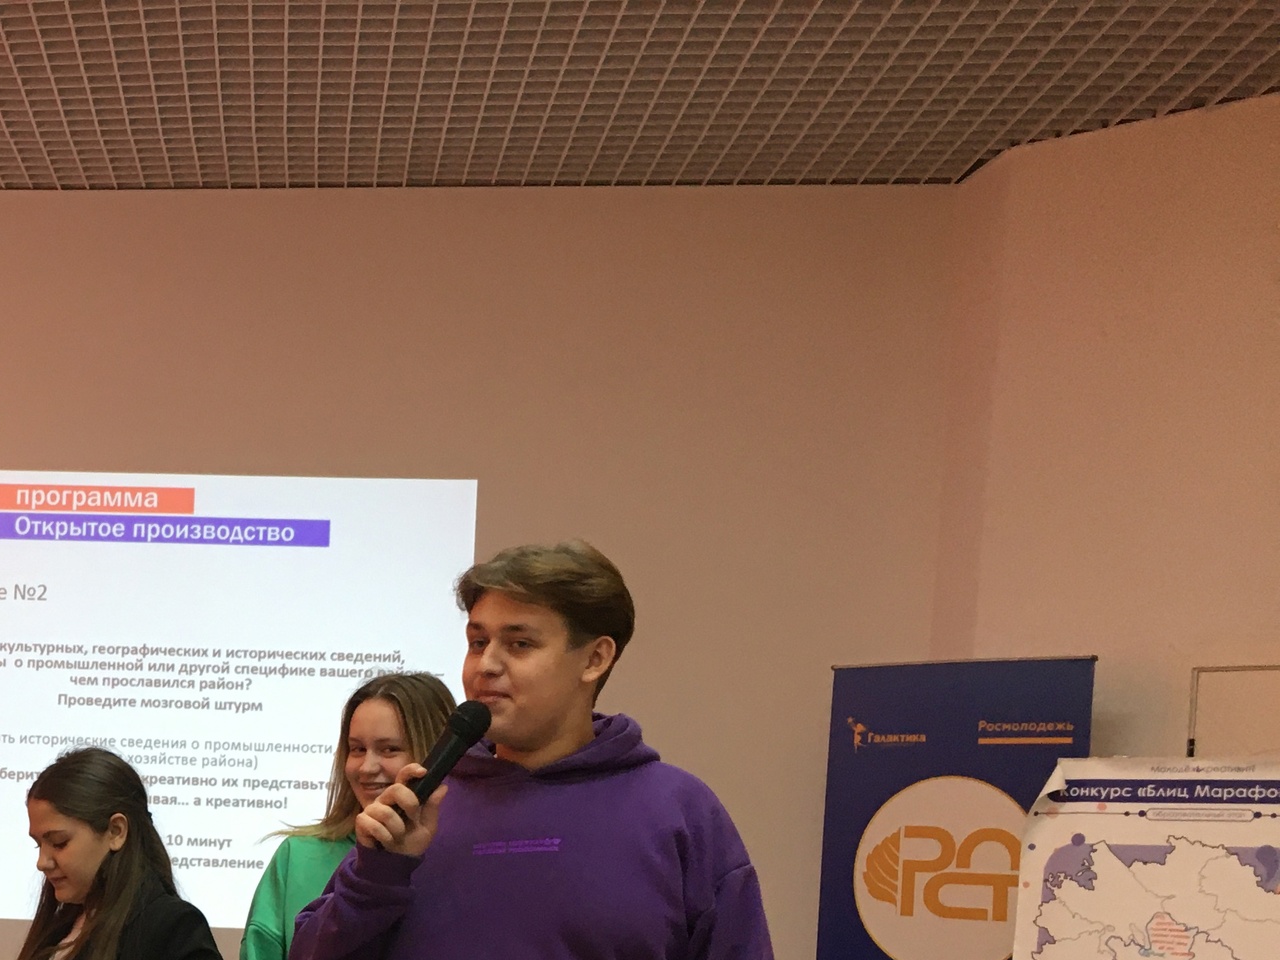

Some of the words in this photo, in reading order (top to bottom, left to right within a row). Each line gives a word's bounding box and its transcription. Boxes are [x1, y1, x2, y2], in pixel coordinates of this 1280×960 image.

[16, 489, 159, 510] программа
[14, 516, 125, 540] Открытое
[133, 522, 295, 543] производство
[13, 584, 48, 601] №2
[0, 641, 88, 656] культурных,
[92, 643, 209, 659] географических
[212, 648, 221, 658] и
[225, 648, 326, 662] исторических
[330, 650, 406, 665] сведений,
[14, 658, 23, 668] о
[27, 657, 144, 673] промышленной
[148, 661, 175, 673] или
[178, 660, 231, 676] другой
[234, 664, 316, 678] специфике
[319, 667, 374, 679] вашего
[69, 675, 99, 687] чем
[102, 677, 195, 690] прославился
[199, 677, 253, 692] район?
[57, 693, 137, 709] Проведите
[140, 695, 210, 710] мозговой
[214, 700, 263, 714] штурм
[978, 720, 1074, 732] Росмолодежь
[19, 733, 117, 748] исторические
[120, 737, 187, 751] сведения
[191, 741, 200, 750] о
[867, 732, 927, 743] Галактика
[127, 751, 198, 766] хозяйстве
[201, 755, 258, 770] района)
[140, 774, 217, 787] креативно
[221, 777, 239, 788] их
[1060, 784, 1133, 800] Конкурс
[1137, 785, 1190, 799] «Блиц
[1194, 785, 1280, 801] Марафо
[193, 797, 202, 806] а
[205, 796, 288, 810] креативно!
[166, 833, 184, 847] 10
[186, 837, 233, 850] минут
[171, 856, 265, 870] едставление
